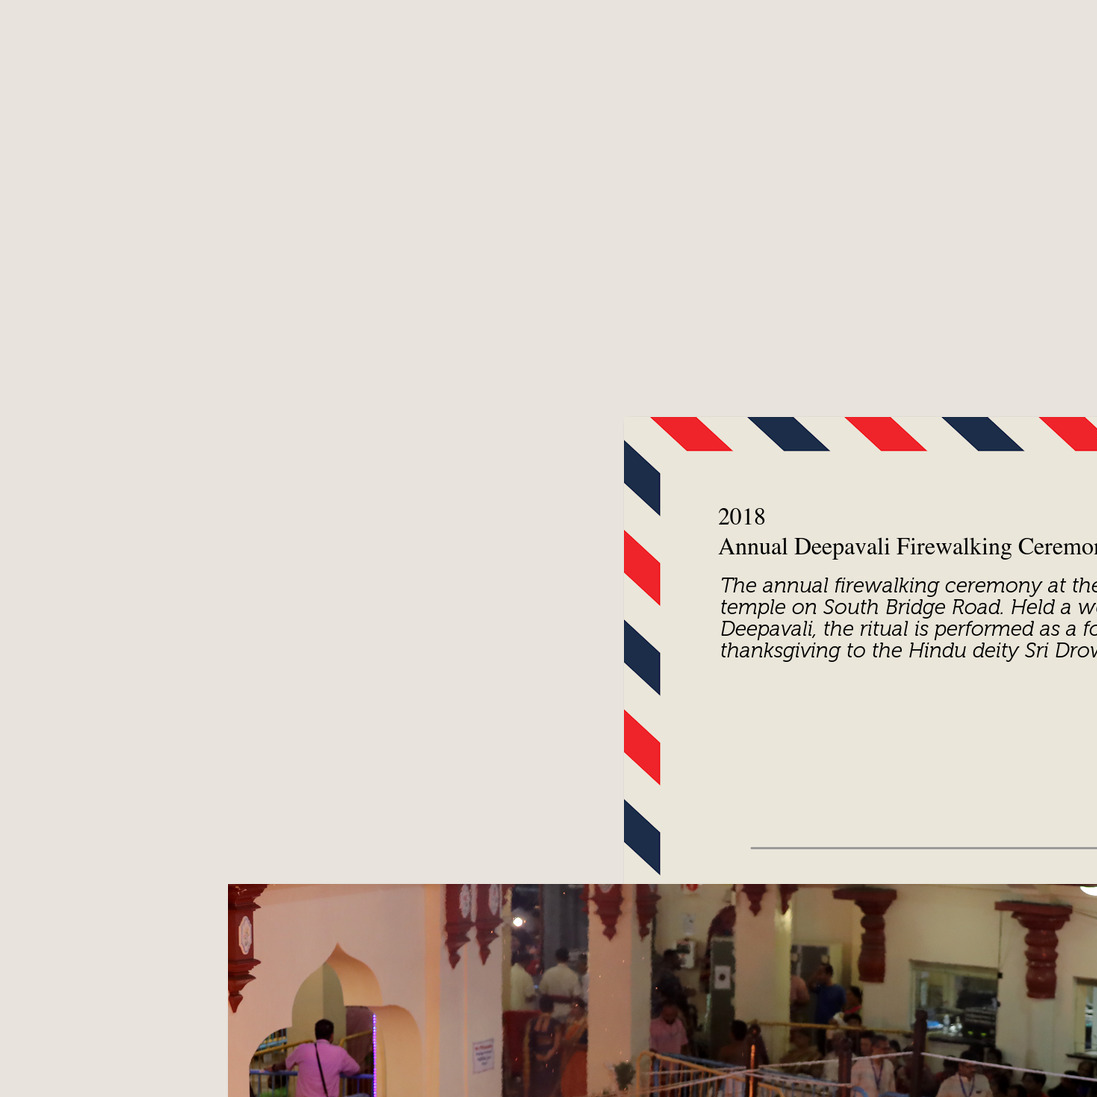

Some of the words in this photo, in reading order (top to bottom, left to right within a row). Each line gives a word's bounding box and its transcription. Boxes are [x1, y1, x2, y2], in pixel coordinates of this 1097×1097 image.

[718, 508, 765, 525] 2018
[718, 537, 788, 555] Annual
[794, 537, 890, 560] Deepavali
[896, 537, 1012, 560] Firewalking
[721, 577, 757, 593] The
[762, 577, 828, 593] annual
[835, 577, 940, 597] firewalking
[945, 581, 1043, 597] ceremony
[1048, 578, 1066, 593] at
[721, 599, 786, 619] temple
[792, 603, 816, 615] on
[823, 599, 878, 615] South
[886, 599, 945, 619] Bridge
[952, 599, 1003, 615] Road.
[1011, 599, 1055, 615] Held
[1060, 603, 1071, 615] a
[721, 620, 816, 641] Deepavali,
[824, 620, 854, 636] the
[860, 620, 908, 636] ritual
[915, 620, 929, 636] is
[934, 620, 1034, 641] performed
[1040, 624, 1060, 636] as
[1066, 624, 1076, 636] a
[721, 642, 842, 662] thanksgiving
[847, 643, 865, 658] to
[873, 642, 902, 658] the
[909, 642, 966, 658] Hindu
[973, 642, 1020, 662] deity
[1025, 642, 1049, 658] Sri
